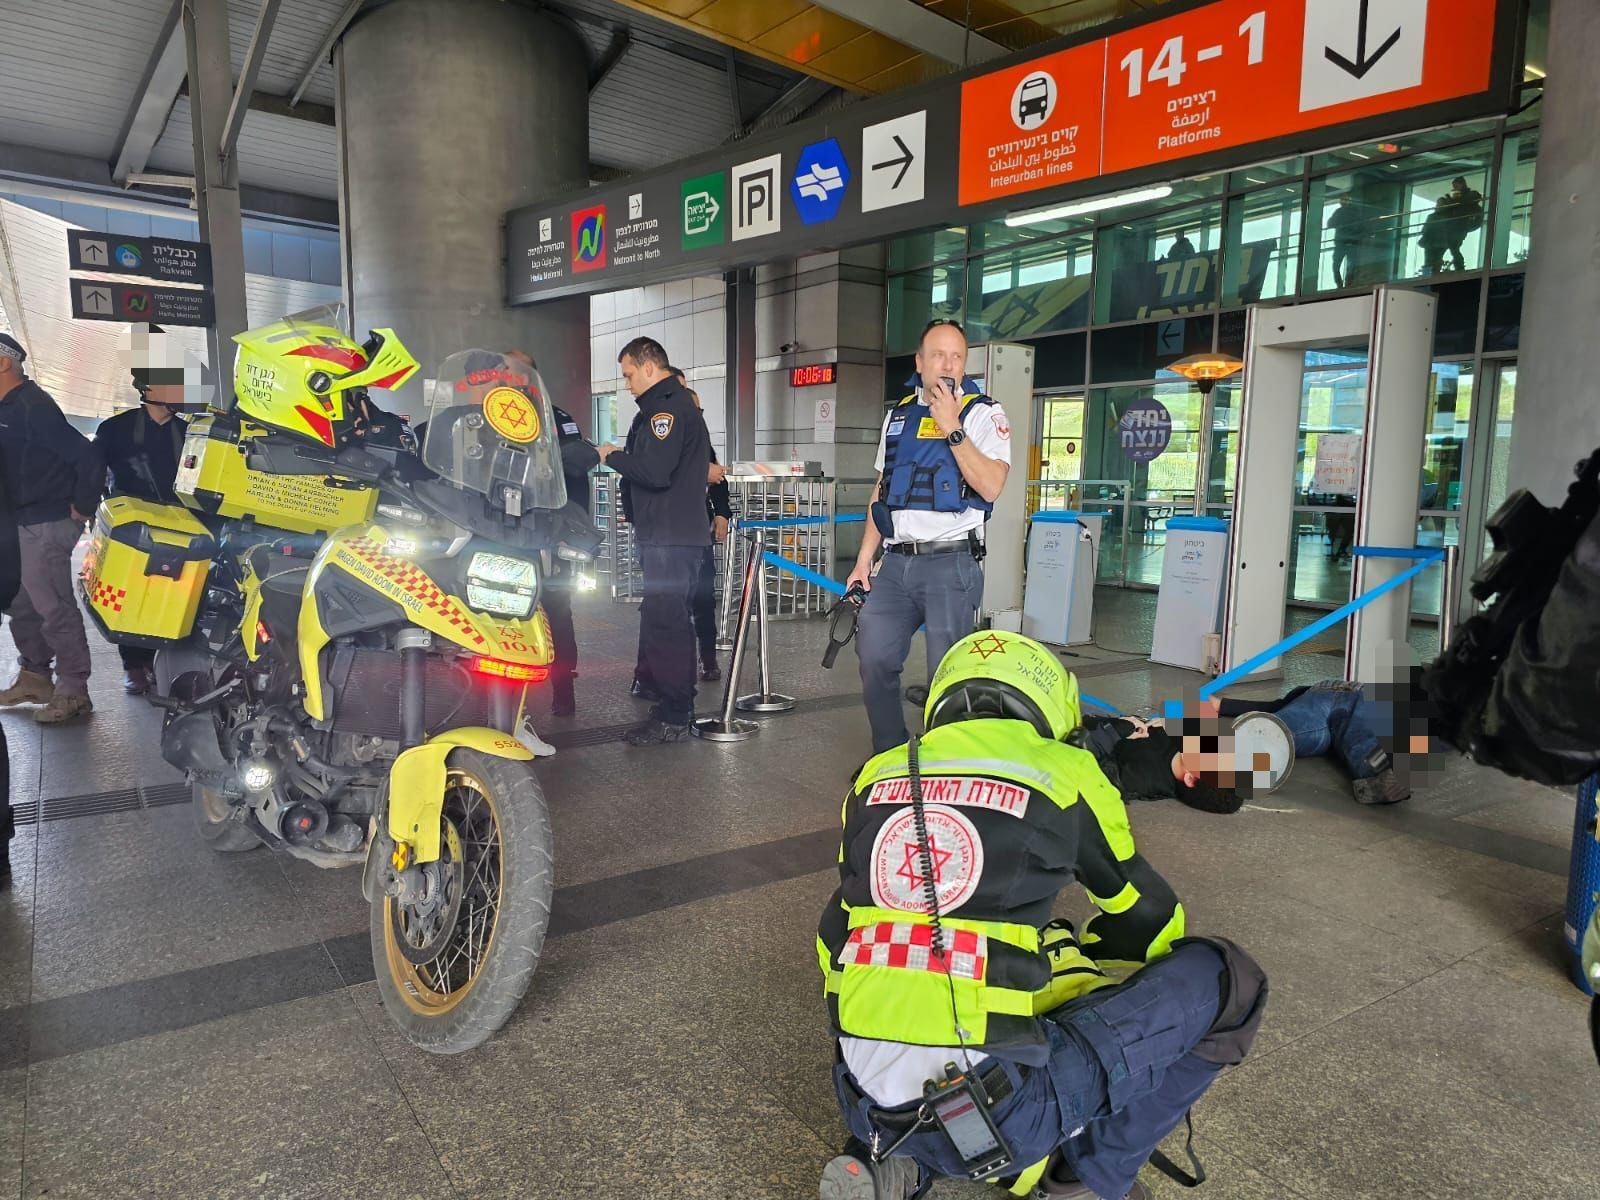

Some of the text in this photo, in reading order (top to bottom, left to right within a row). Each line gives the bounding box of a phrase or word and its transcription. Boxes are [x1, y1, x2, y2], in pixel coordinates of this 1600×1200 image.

[1167, 90, 1216, 112] רציפים
[988, 125, 1079, 158] קוים בינעירוניים
[1158, 126, 1221, 150] Platforms
[989, 142, 1076, 172] خطوط بين البلدات
[990, 161, 1073, 188] Interurban lines
[688, 203, 706, 216] יציאה
[152, 245, 197, 259] רכבלית
[644, 247, 660, 260] North
[160, 266, 192, 277] Rakvalit
[246, 363, 275, 380] מגן דוד
[252, 377, 273, 391] אדום
[1121, 430, 1166, 448] ננצח
[252, 482, 273, 492] DAVID
[336, 550, 423, 614] MAGEN DAVID ADOM IN ISRAEL
[498, 640, 538, 655] 101
[1045, 665, 1059, 682] מגן
[966, 780, 1025, 810] יחידת
[924, 815, 950, 828] אדום
[886, 818, 913, 846] ישראל
[960, 845, 968, 863] מגן
[880, 858, 888, 889] MAGEN
[901, 899, 927, 909] ADOM
